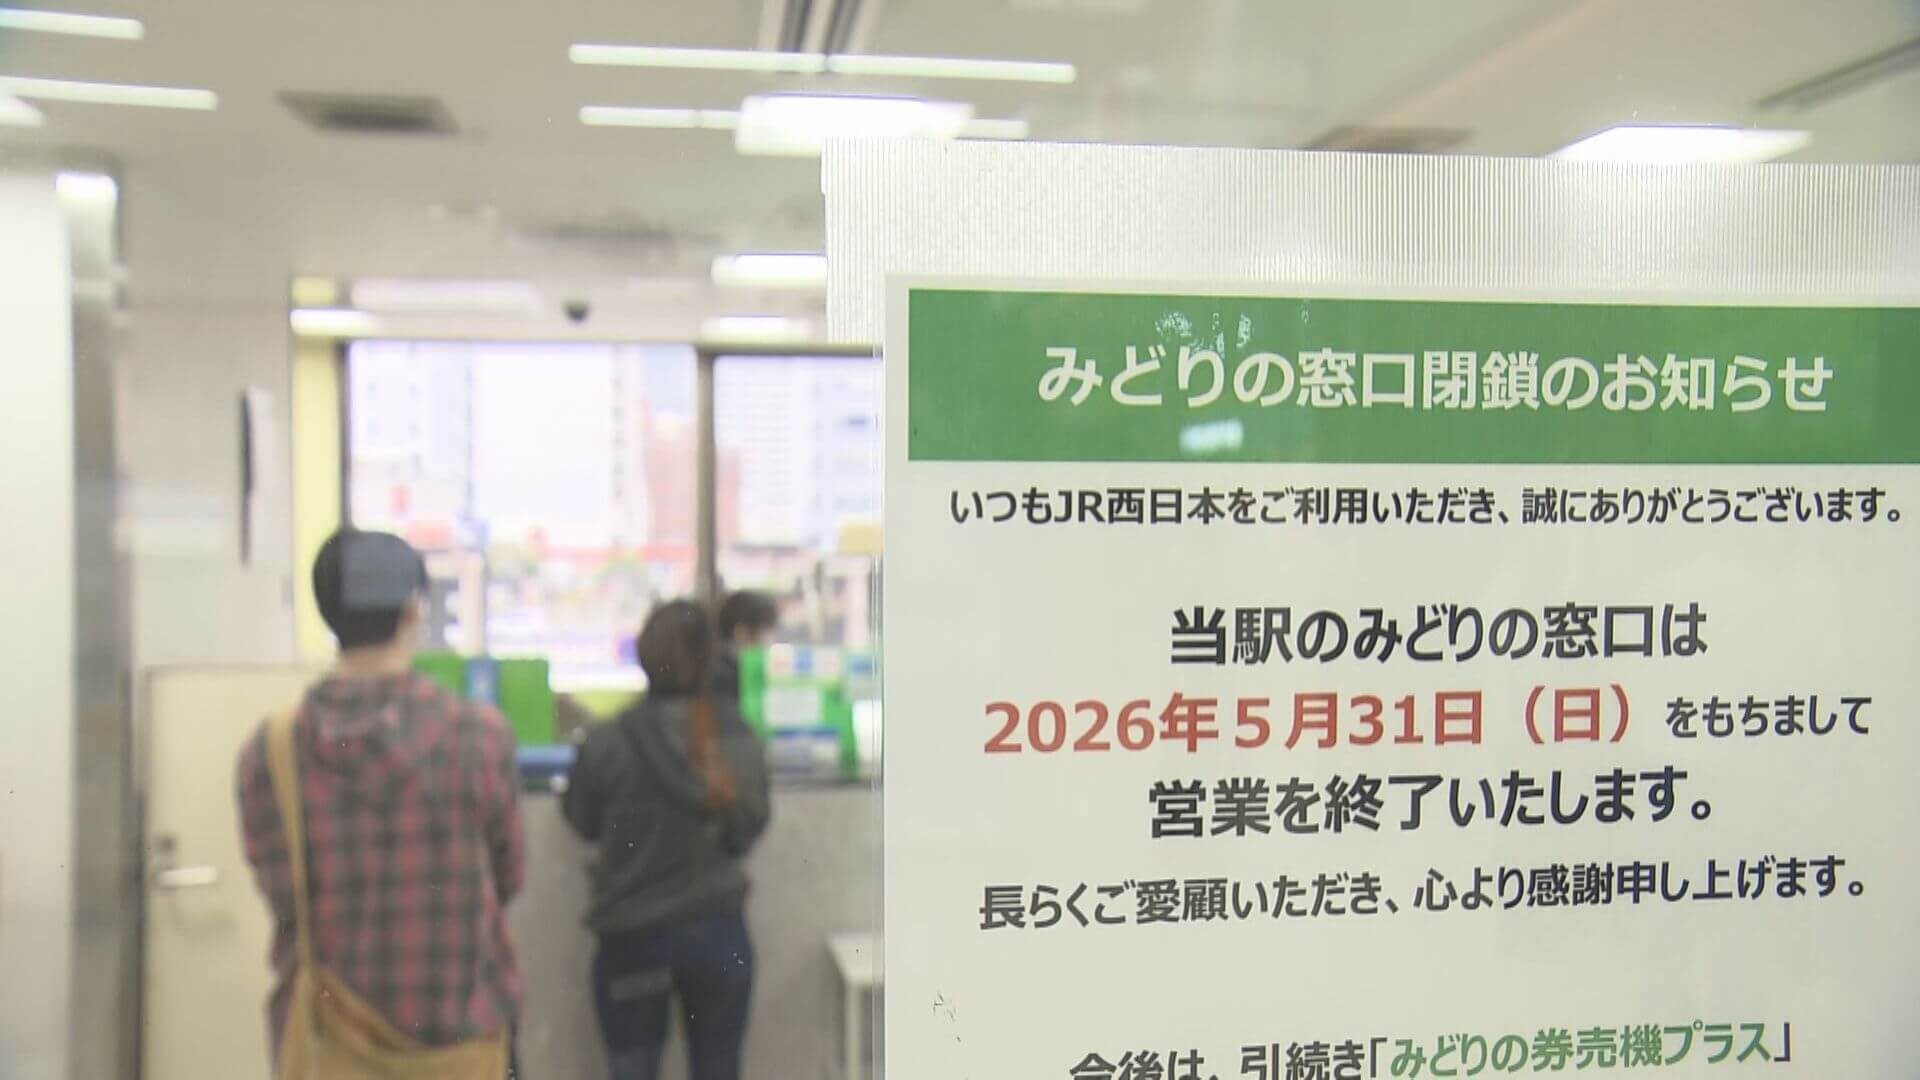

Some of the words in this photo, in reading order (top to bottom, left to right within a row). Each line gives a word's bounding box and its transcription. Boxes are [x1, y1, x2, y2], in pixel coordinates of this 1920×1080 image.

[1039, 346, 1833, 412] みどりの窓口閉鎖のお知らせ
[951, 486, 1901, 525] いつもJR西日本をご利用いただき、誠にありがとうございます。
[1171, 602, 1708, 666] 当駅のみどりの窓口は
[1149, 765, 1712, 839] 営業を終了いたします。
[980, 855, 1865, 930] 長らくご愛顧いただき、心より感謝申し上げます。
